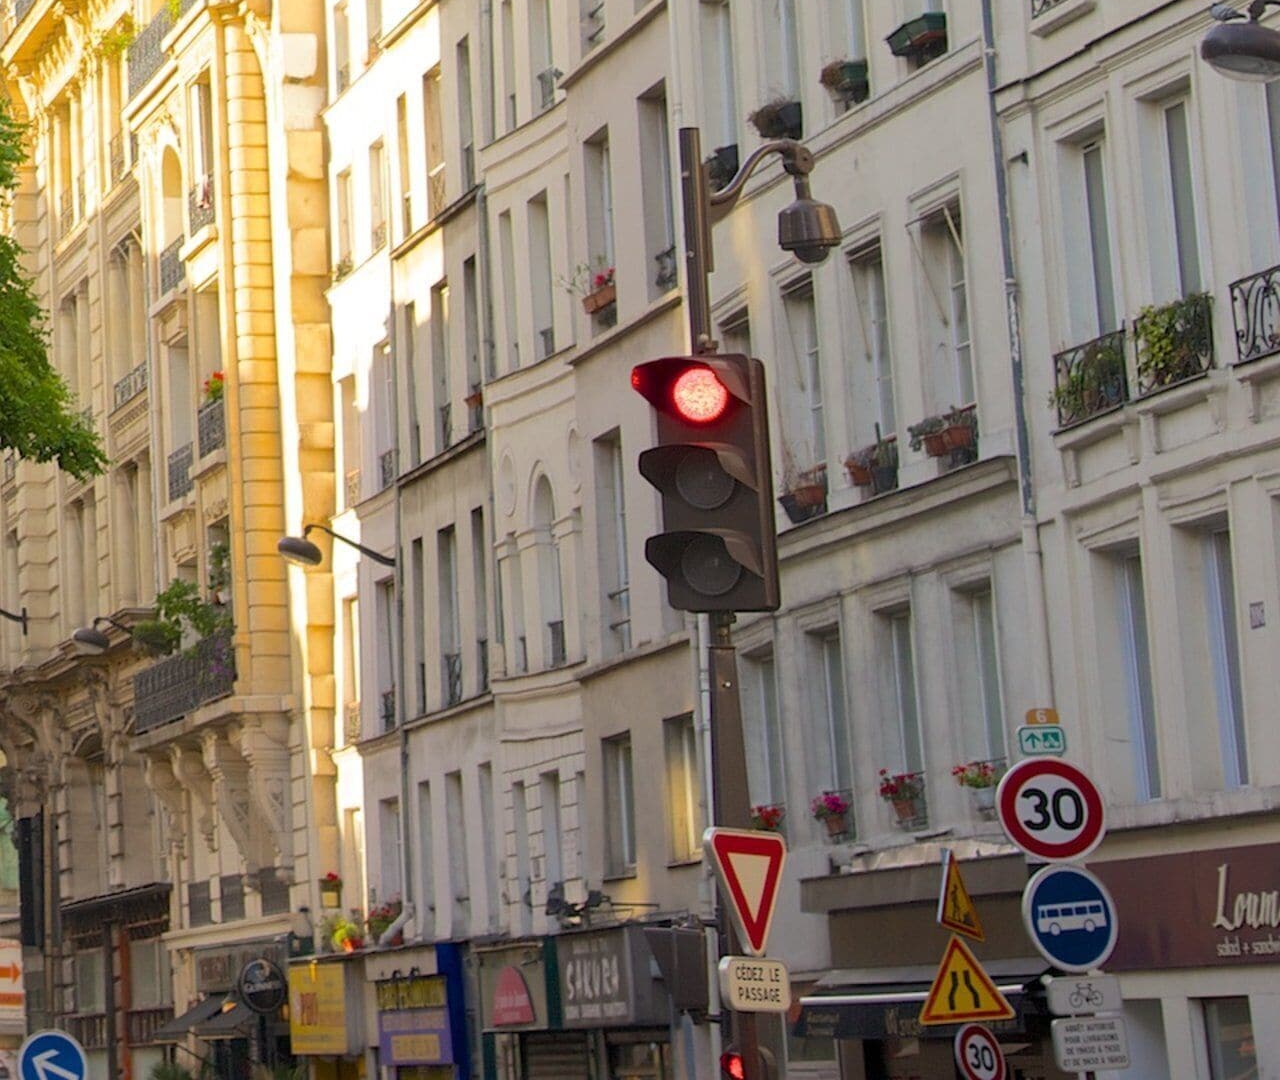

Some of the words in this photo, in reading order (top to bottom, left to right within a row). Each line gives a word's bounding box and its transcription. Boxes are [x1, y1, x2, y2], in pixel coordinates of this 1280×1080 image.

[1021, 787, 1084, 831] 30
[736, 963, 764, 983] CÉDEZ
[770, 968, 781, 983] LE
[738, 987, 782, 1003] PASSAGE
[968, 1043, 995, 1072] 30
